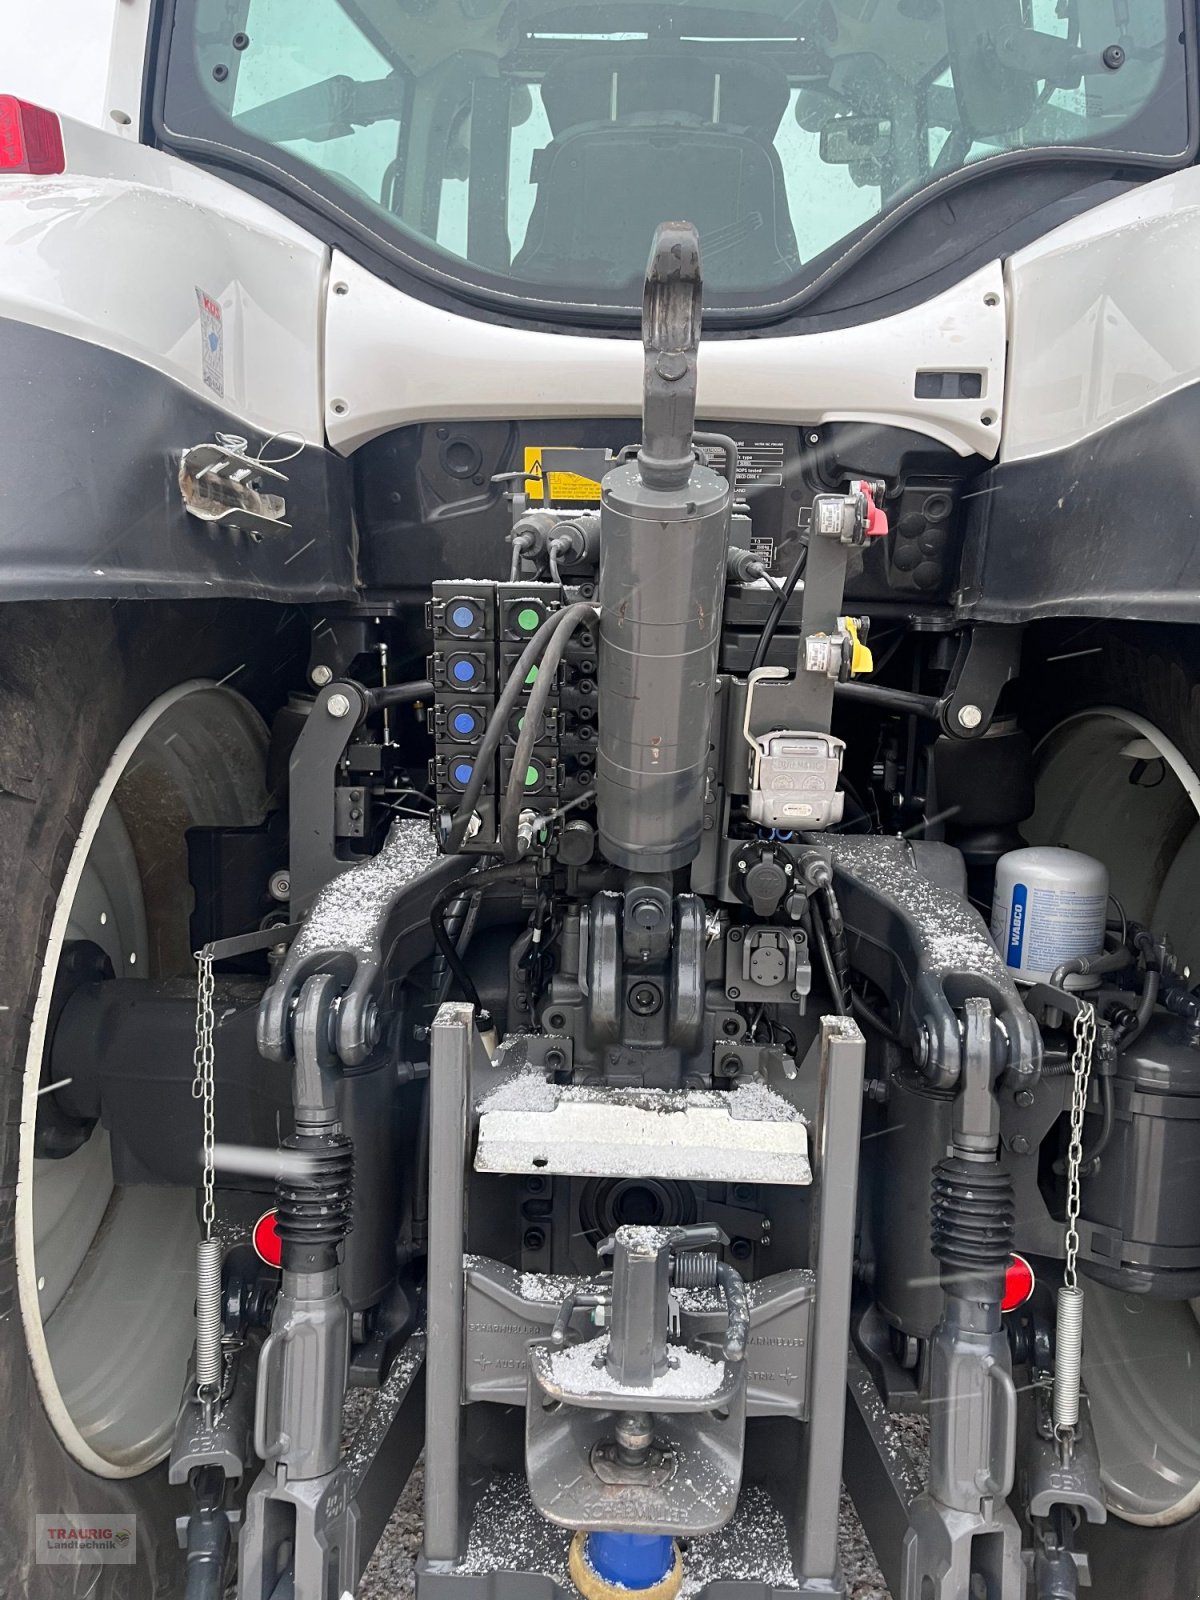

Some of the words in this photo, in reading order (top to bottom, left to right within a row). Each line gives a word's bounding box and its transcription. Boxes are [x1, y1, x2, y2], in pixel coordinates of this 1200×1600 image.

[1011, 904, 1023, 946] WABCO
[749, 1335, 805, 1348] ARMUELLER
[747, 1370, 776, 1381] STRIA
